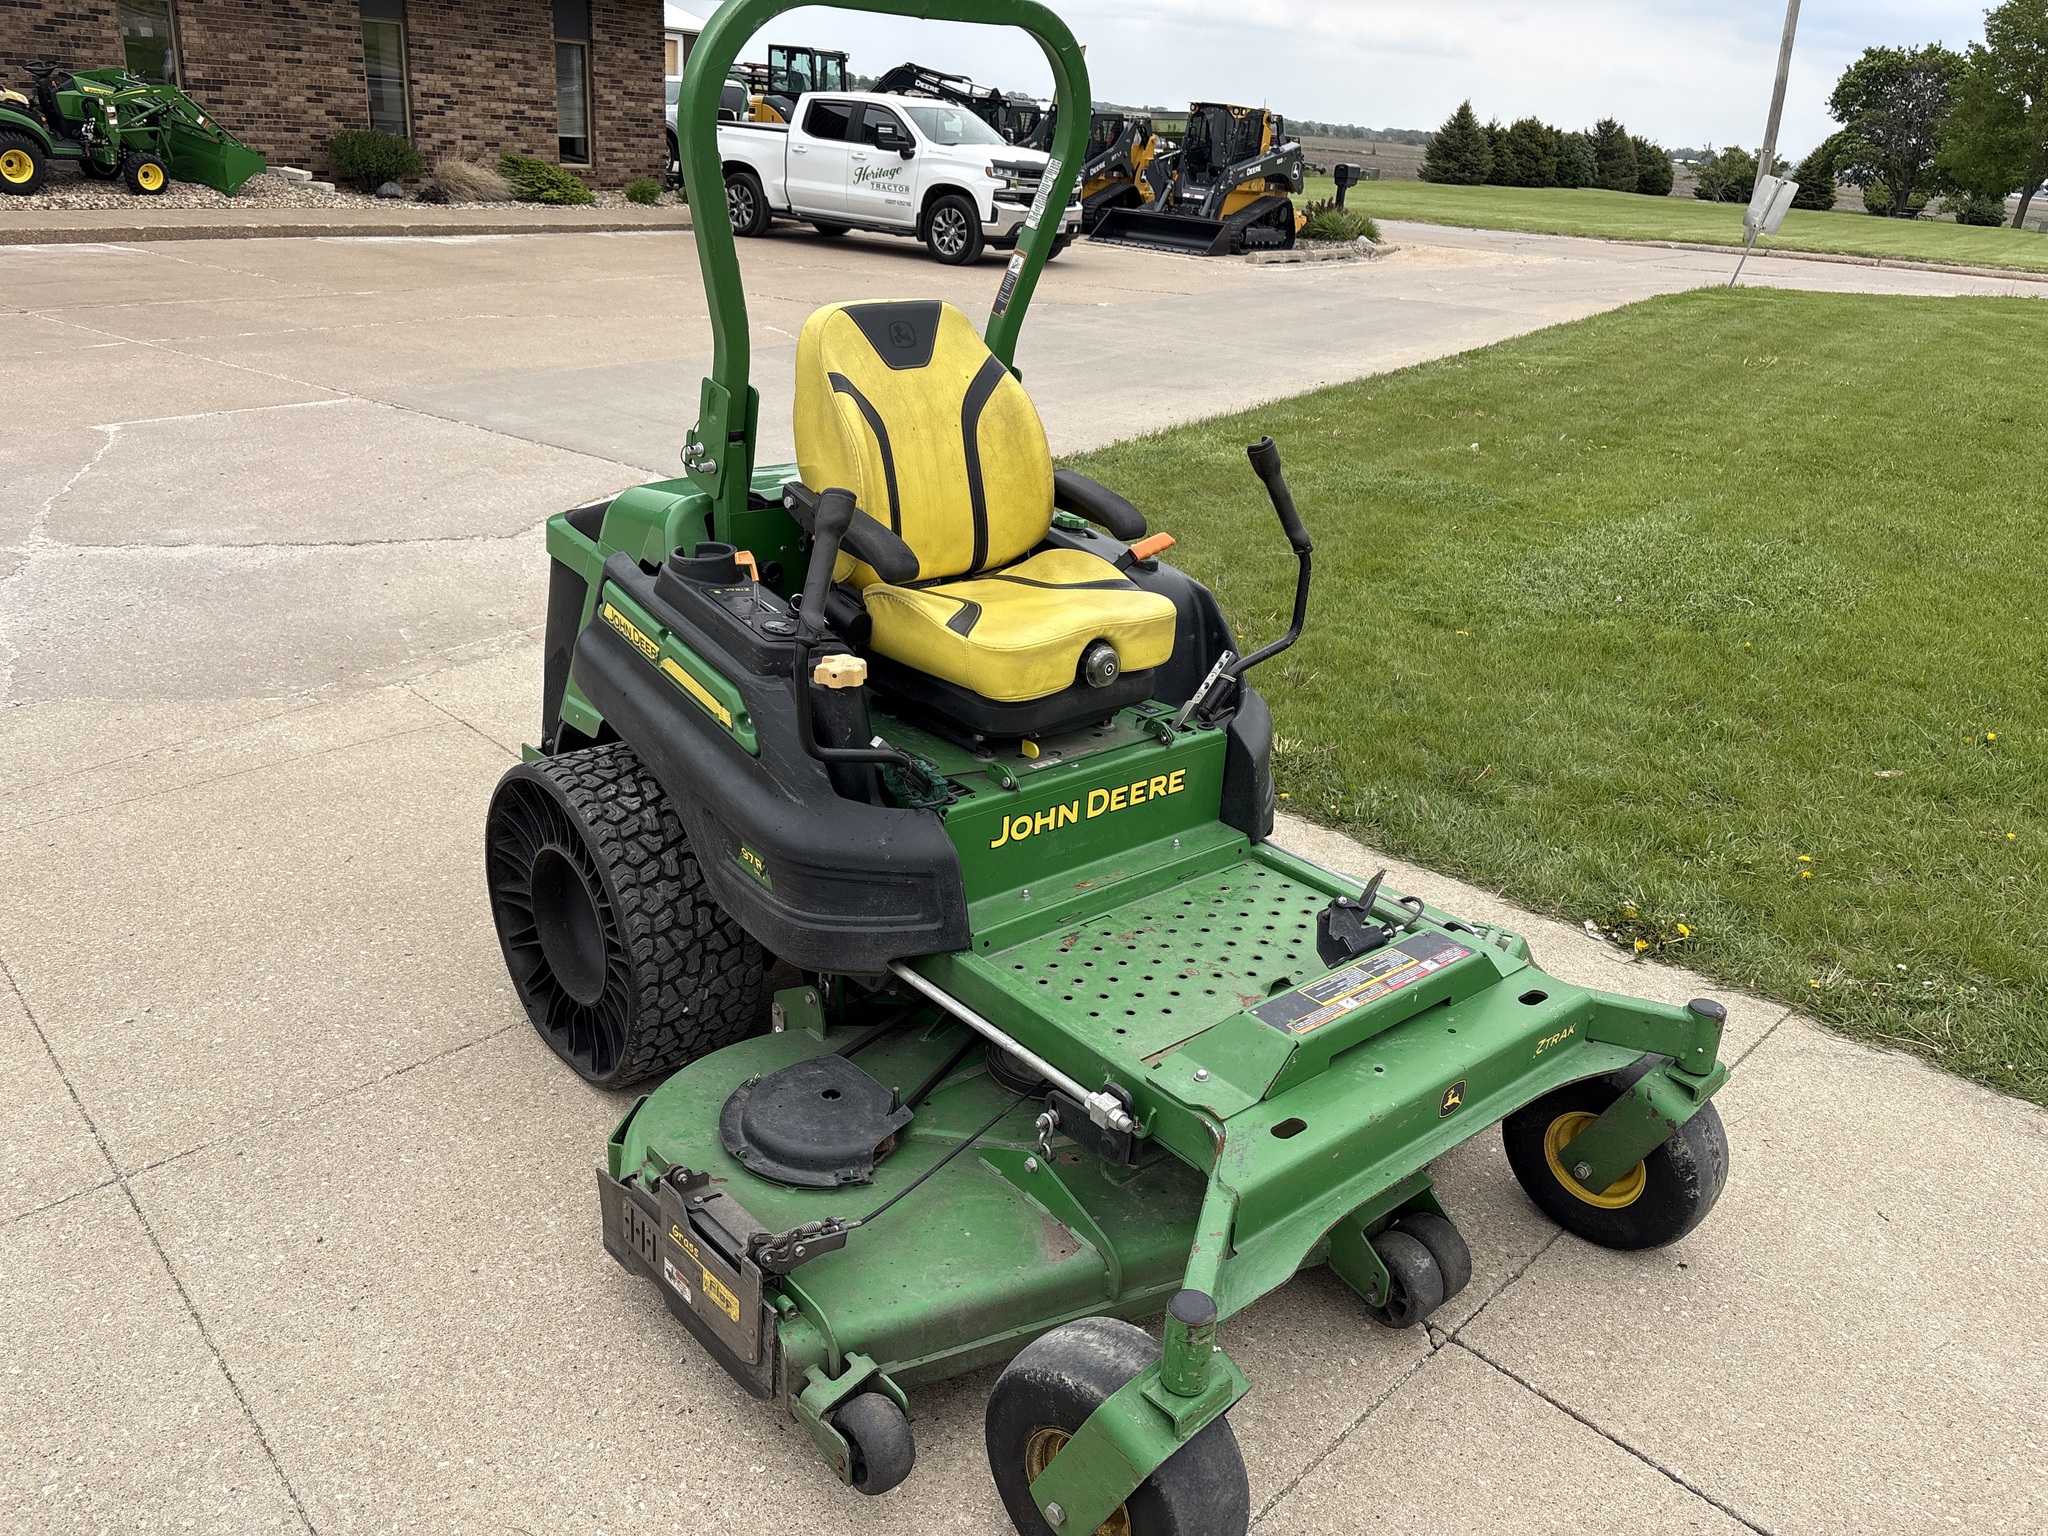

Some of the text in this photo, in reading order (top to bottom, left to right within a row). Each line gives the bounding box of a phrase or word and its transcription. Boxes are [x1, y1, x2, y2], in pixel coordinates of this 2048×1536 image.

[915, 79, 940, 94] DEERE
[853, 165, 902, 185] Heritage
[1090, 160, 1106, 176] DEERE
[1246, 165, 1262, 176] DEERE
[871, 182, 910, 193] TRACTOR
[609, 609, 658, 659] JOHN DEER
[990, 767, 1187, 849] JOHN DEERE
[1534, 1021, 1578, 1056] ZTRAK
[671, 1224, 699, 1257] Grass
[709, 1279, 732, 1310] Flap
